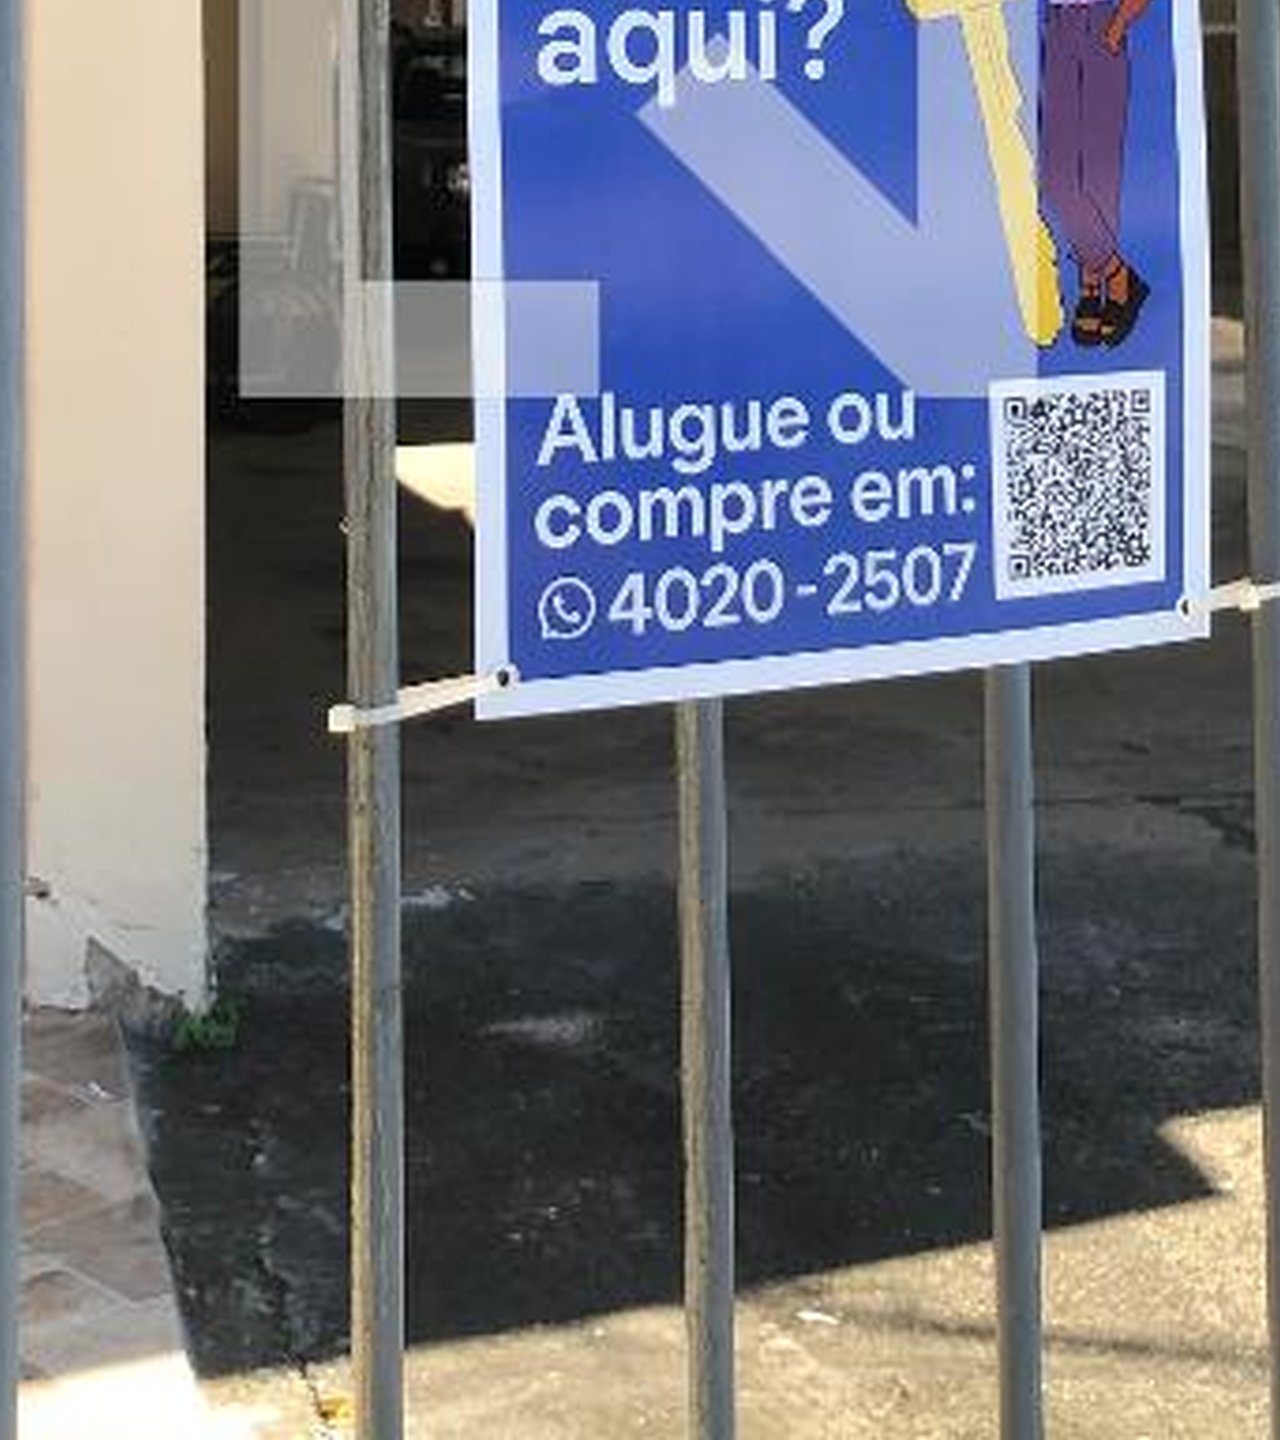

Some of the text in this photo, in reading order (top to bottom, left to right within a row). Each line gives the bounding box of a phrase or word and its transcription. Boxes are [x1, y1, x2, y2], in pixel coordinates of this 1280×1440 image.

[536, 389, 916, 474] Alugue ou
[534, 462, 977, 551] compre em:
